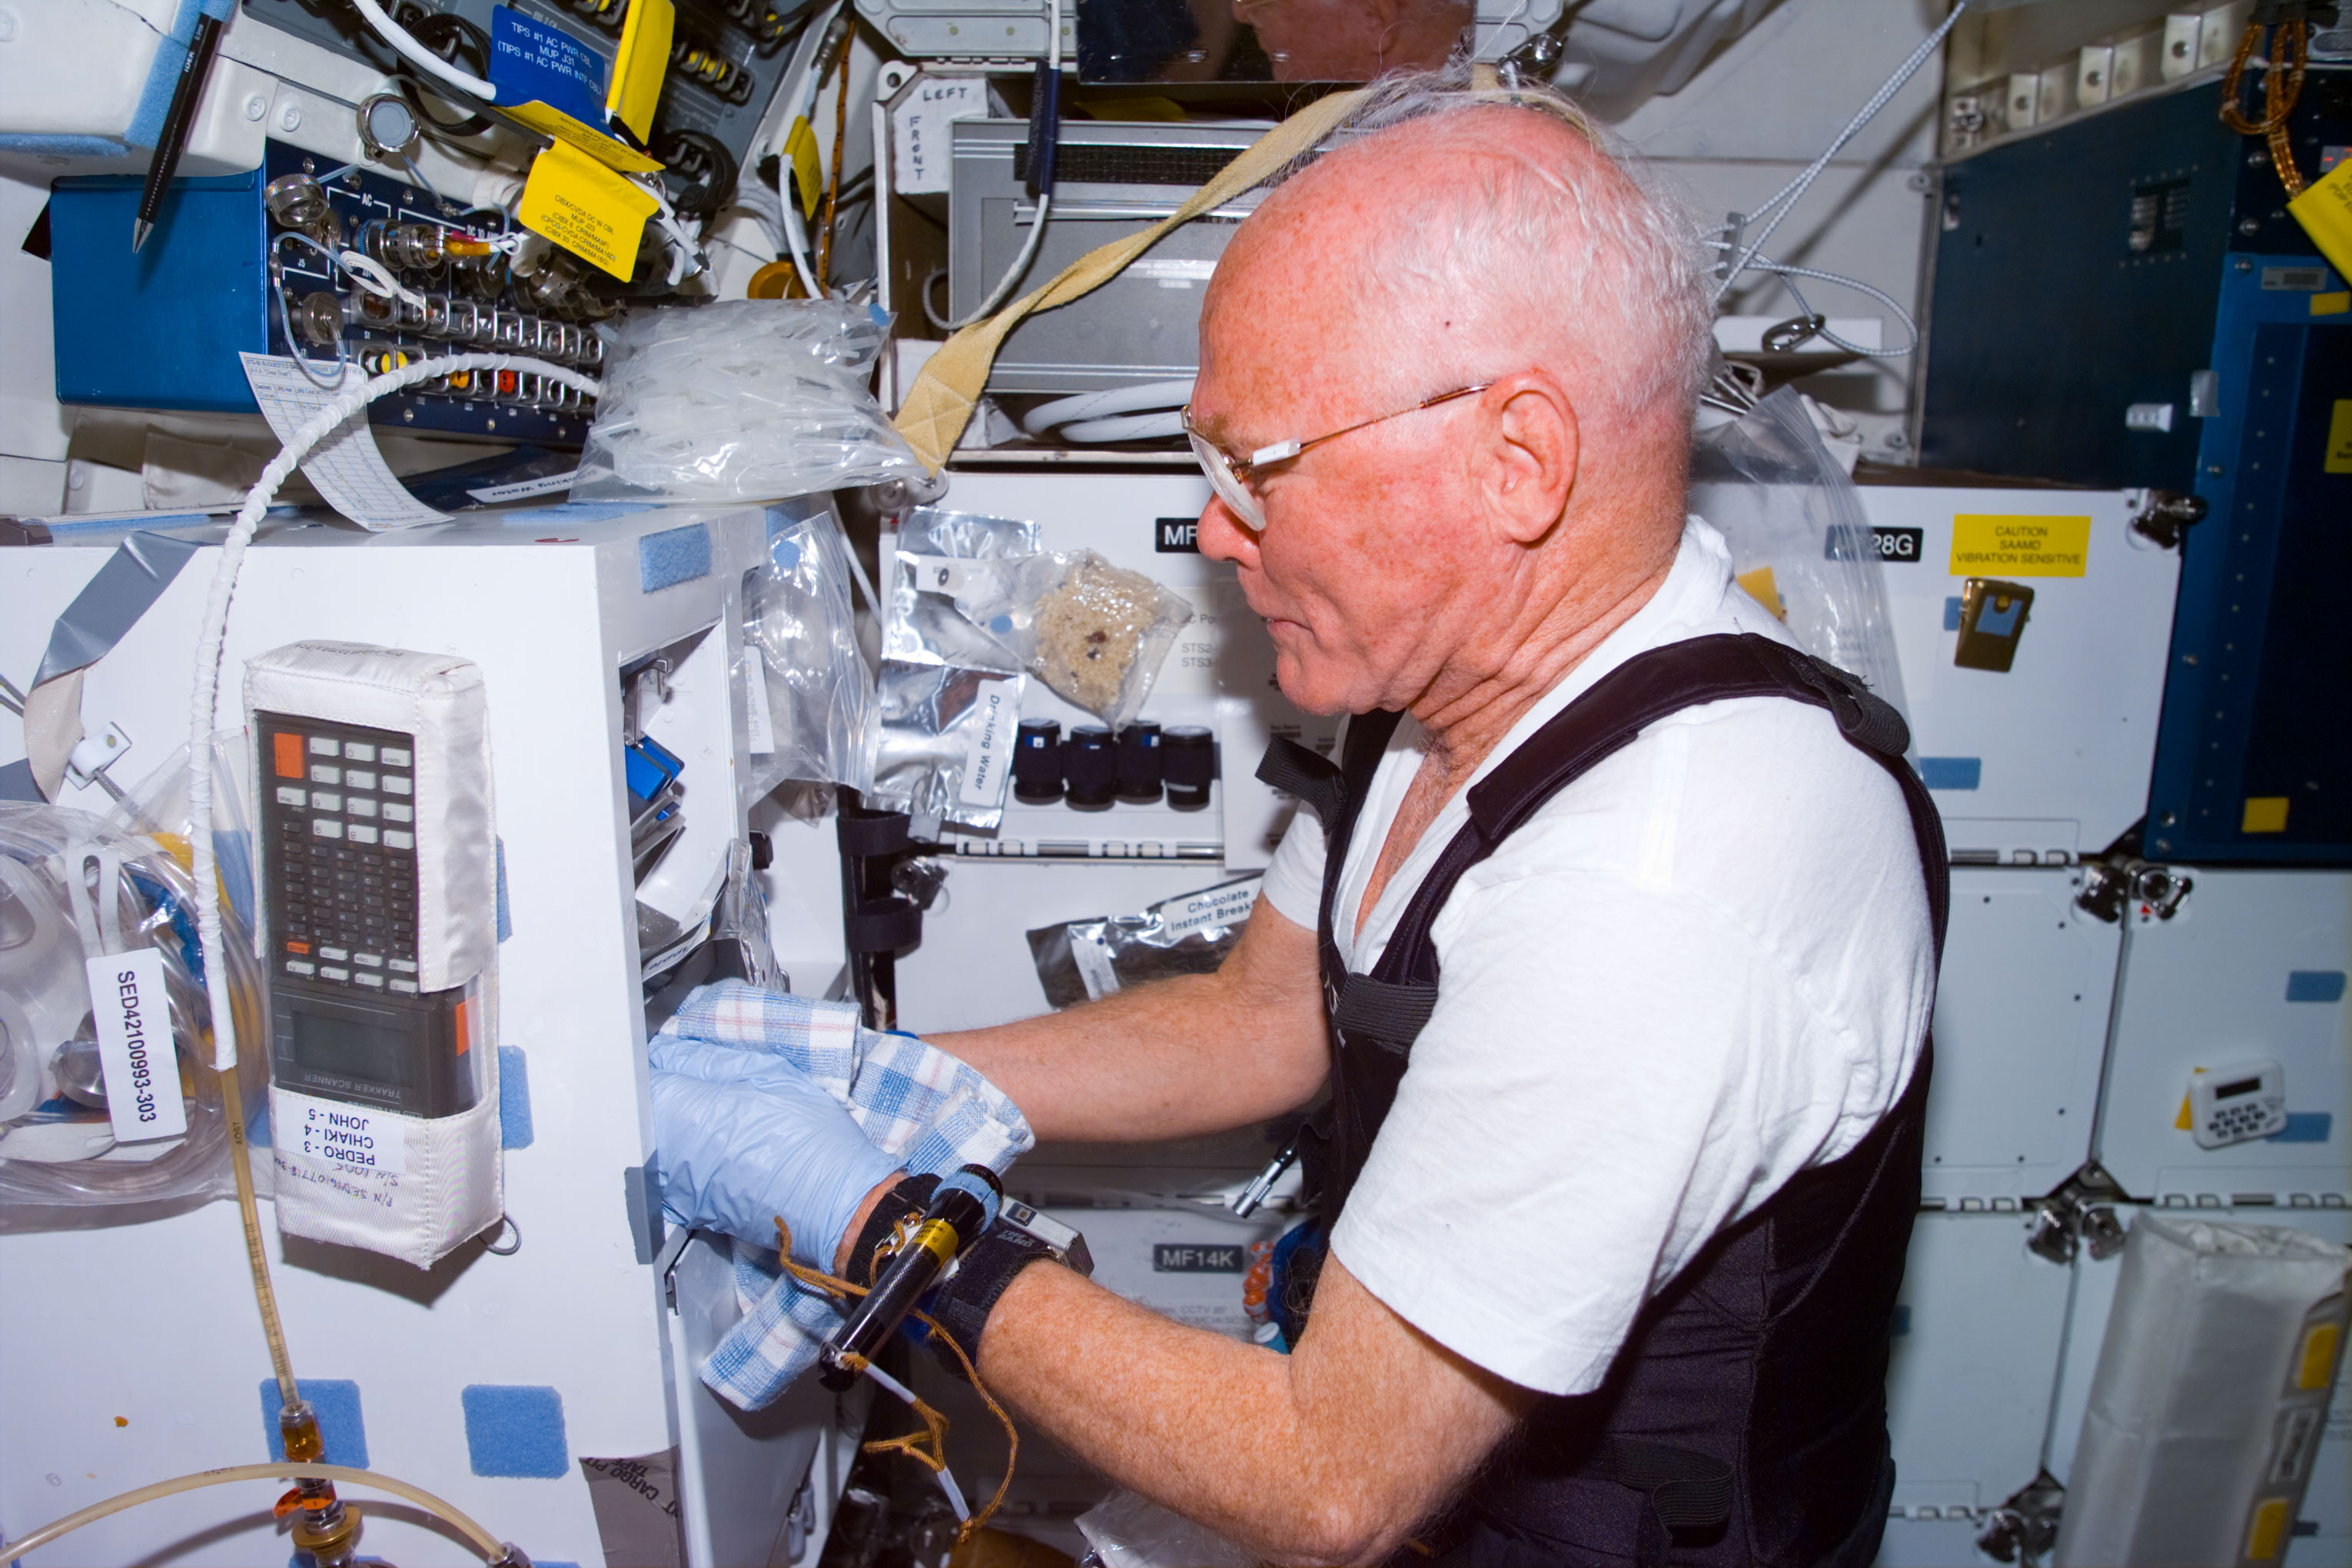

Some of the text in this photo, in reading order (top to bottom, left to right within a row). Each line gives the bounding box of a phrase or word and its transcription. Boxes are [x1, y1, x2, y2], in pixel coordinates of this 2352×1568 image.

[511, 22, 530, 38] TIPS
[533, 32, 543, 43] #1
[546, 37, 559, 48] AC
[561, 42, 579, 58] PWR
[497, 41, 521, 57] (TIPS
[524, 51, 534, 61] #1
[537, 56, 549, 68] AC
[551, 61, 572, 76] PWR
[539, 45, 575, 66] MUP J31
[922, 87, 968, 101] LEFT
[909, 115, 925, 181] FRONT
[361, 191, 374, 207] AC
[1164, 524, 1198, 546] MF
[1995, 526, 2048, 537] CAUTION
[1956, 550, 2082, 565] VIBRATION SENSITIVE
[1181, 643, 1217, 654] STS2-
[1181, 658, 1217, 669] STS3-
[975, 694, 1000, 790] Drinking Water
[1188, 889, 1250, 913] Chocolate
[1171, 902, 1255, 932] Instant Break
[117, 970, 157, 1122] SED42100993-303
[304, 1073, 401, 1098] TRAKKER SCANNER
[308, 1108, 317, 1121] 5
[329, 1112, 370, 1131] JOHN
[304, 1125, 313, 1136] 4
[324, 1128, 374, 1149] CHIAKI
[304, 1141, 311, 1153] 3
[324, 1145, 376, 1165] PEDRO
[1162, 1249, 1234, 1267] MF14K
[610, 1467, 659, 1500] CARGO
